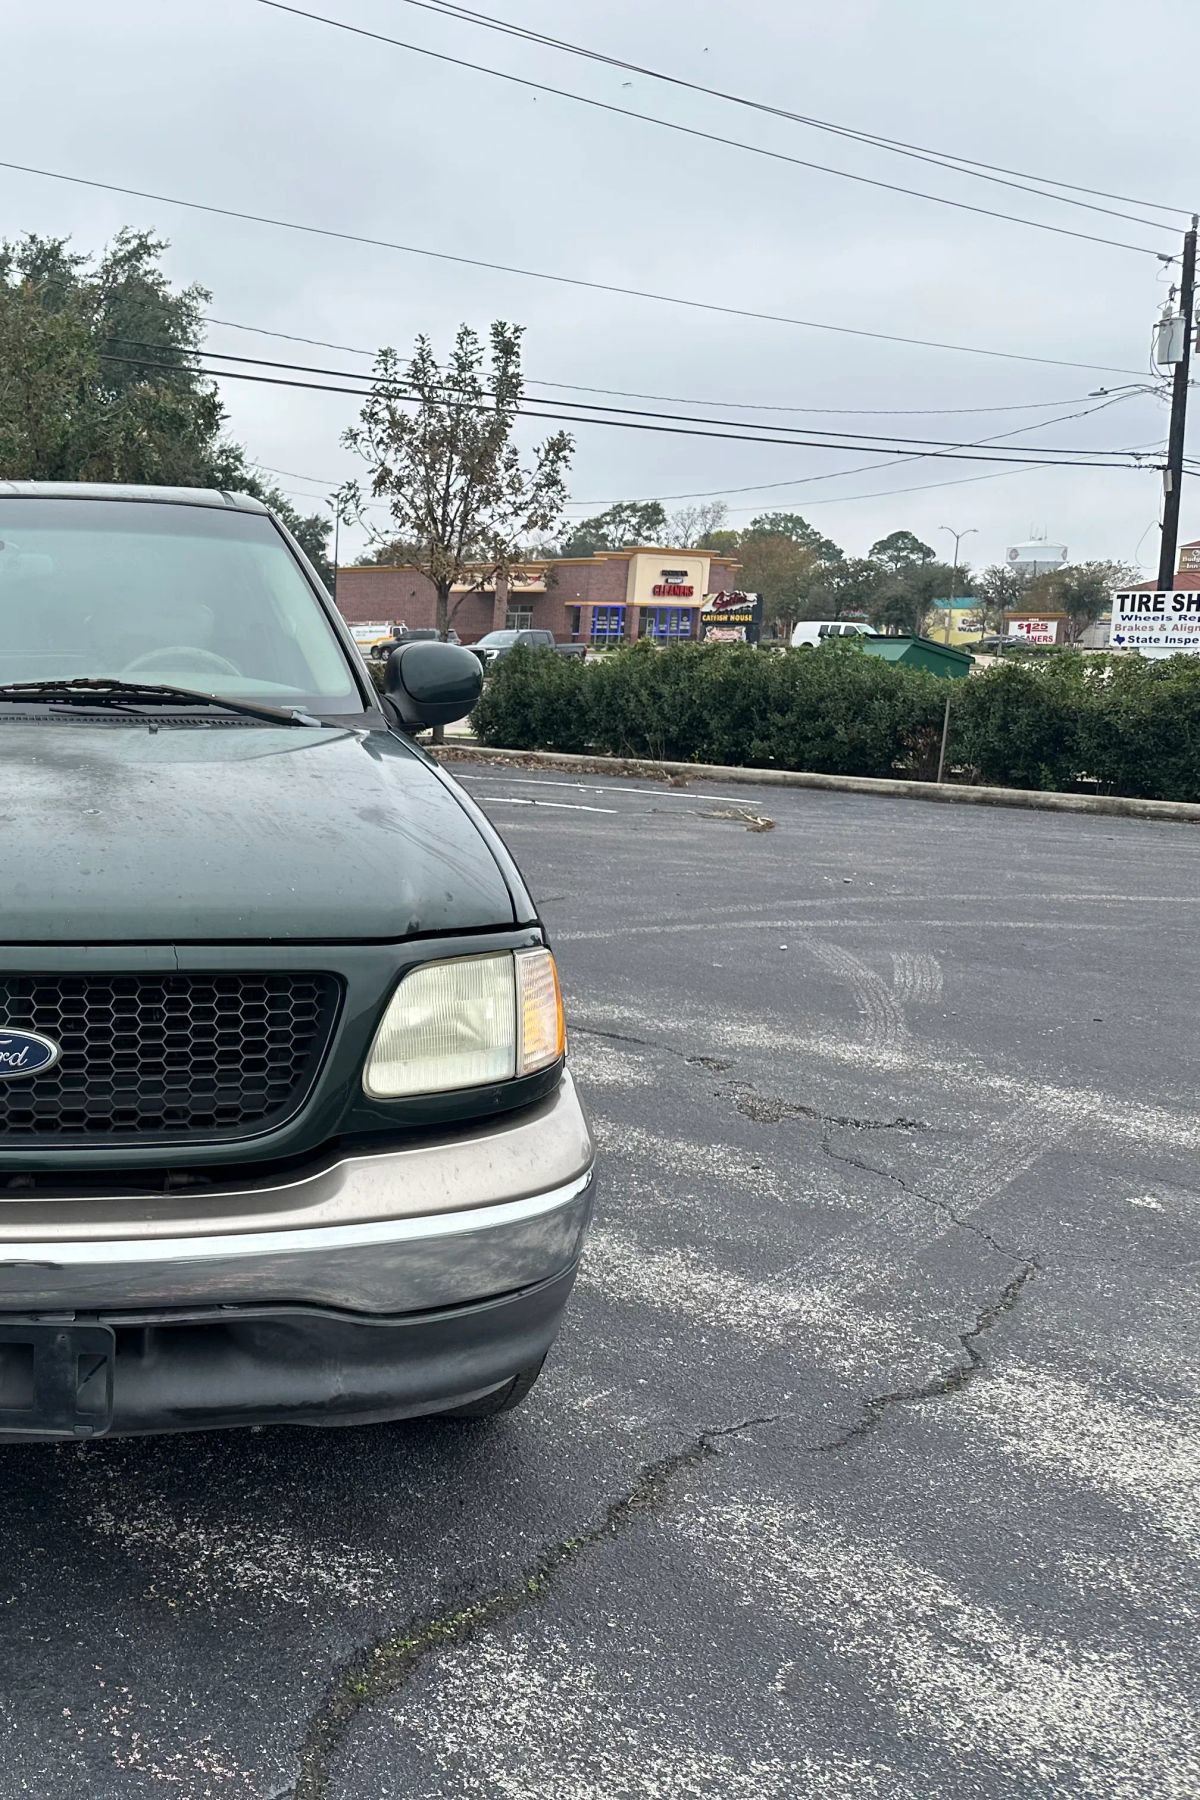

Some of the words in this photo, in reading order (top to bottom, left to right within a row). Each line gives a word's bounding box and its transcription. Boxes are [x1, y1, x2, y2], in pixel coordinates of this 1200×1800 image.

[1116, 594, 1166, 612] TIRE
[1171, 593, 1200, 612] SH
[730, 614, 753, 622] HOUSE
[1114, 623, 1154, 632] Brakes
[1158, 623, 1167, 632] &
[1127, 635, 1161, 644] State
[1164, 635, 1200, 646] Inspe
